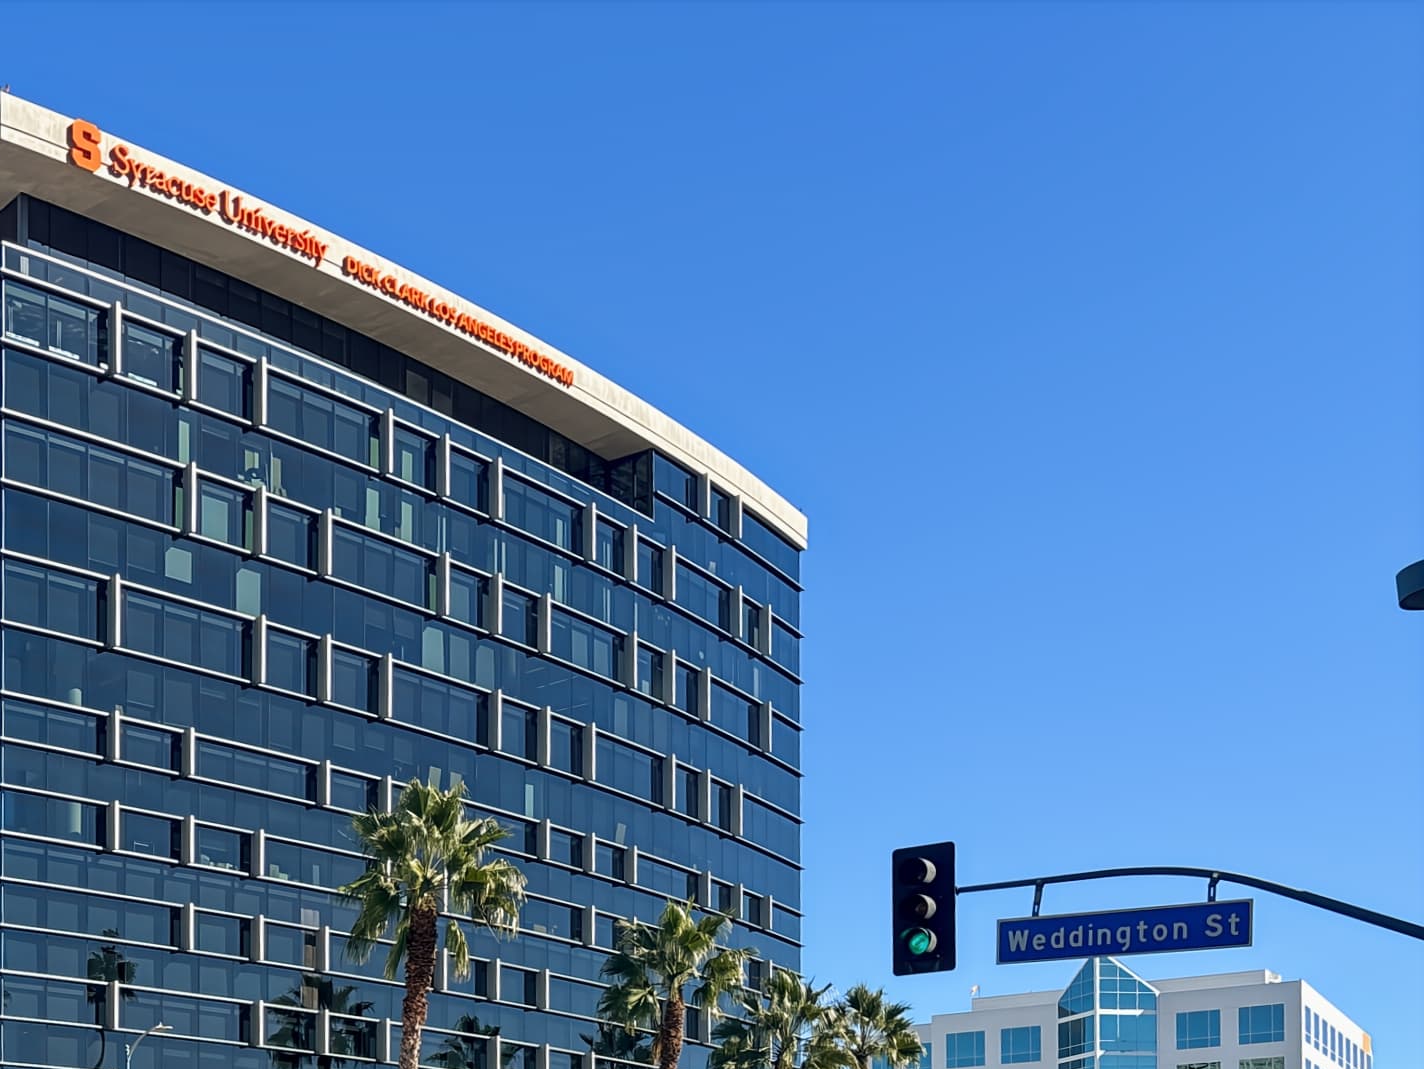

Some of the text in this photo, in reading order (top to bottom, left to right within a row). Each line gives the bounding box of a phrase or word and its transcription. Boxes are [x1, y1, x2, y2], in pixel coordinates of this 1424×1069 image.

[71, 118, 102, 172] S
[111, 144, 331, 270] Syracuse University
[345, 255, 574, 386] DICK CLARK LOS ANGELES PROGRAM
[1008, 912, 1241, 953] Weddington St
